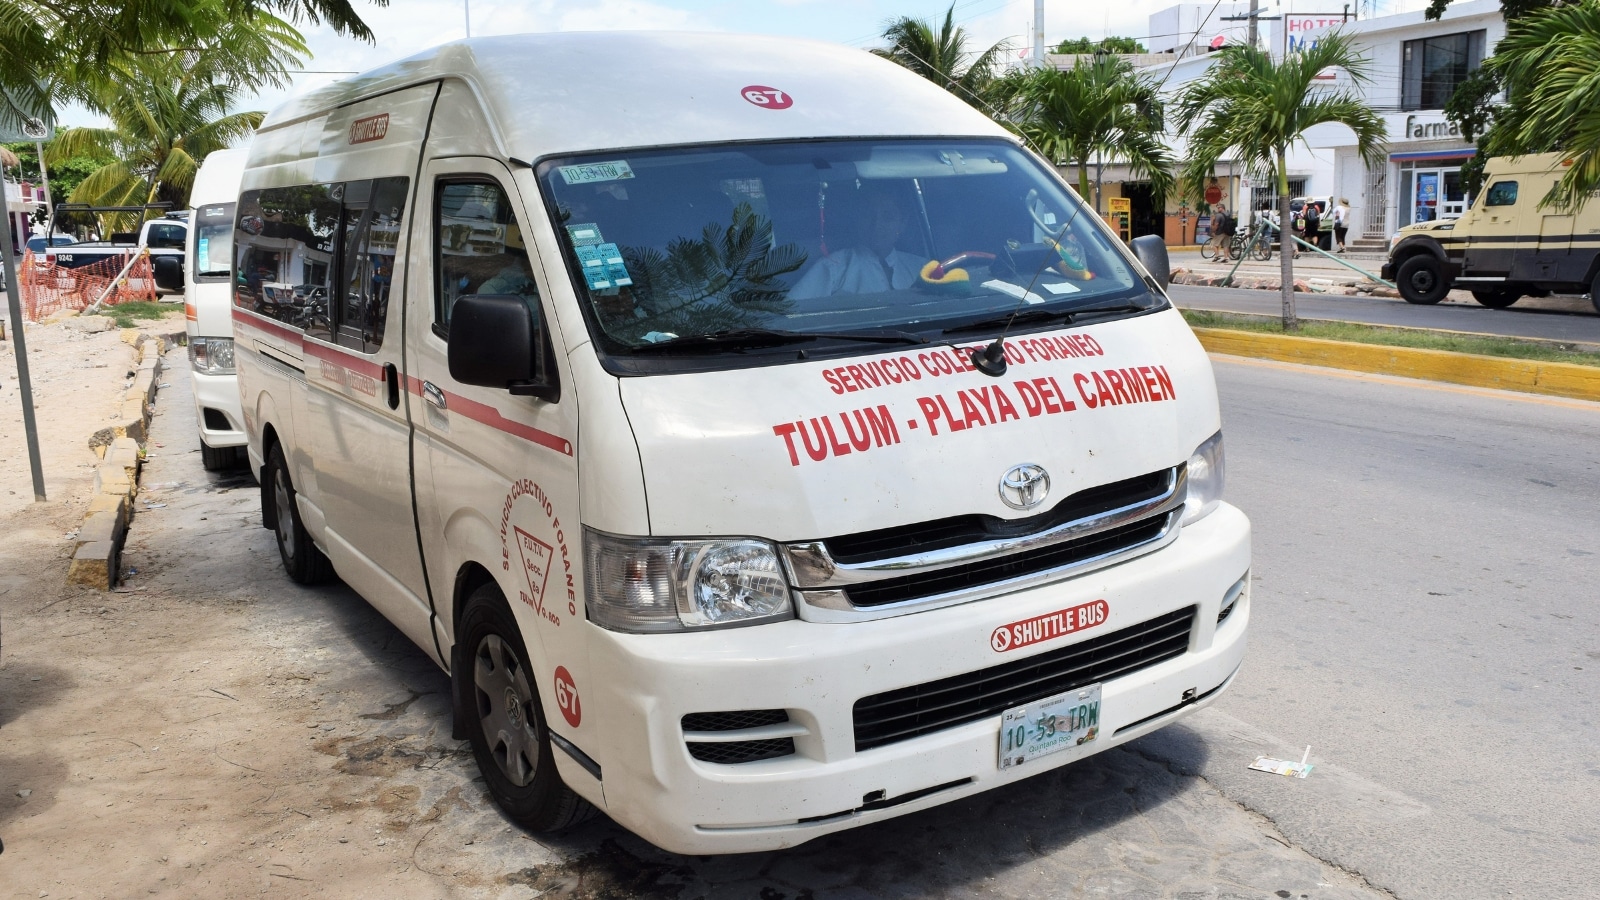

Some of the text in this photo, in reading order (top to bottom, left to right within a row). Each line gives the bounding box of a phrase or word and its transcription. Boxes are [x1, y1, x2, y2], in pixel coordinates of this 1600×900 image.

[1289, 19, 1347, 32] HOT
[744, 90, 785, 104] 67
[58, 254, 74, 262] 9242
[821, 333, 1104, 395] SERVICIO COLEO FORANEO
[772, 404, 901, 467] TULUM
[916, 384, 1021, 437] PLAYA
[1013, 376, 1077, 418] DEL
[1072, 365, 1176, 409] CARMEN
[511, 478, 553, 518] COLECTIVO
[552, 517, 576, 616] FORANEO
[1013, 610, 1075, 646] SHUTTLE
[1078, 602, 1105, 628] BUS
[556, 677, 577, 716] 67
[1006, 700, 1099, 752] 10-53-TRW
[1028, 734, 1072, 754] Quintana Roo
